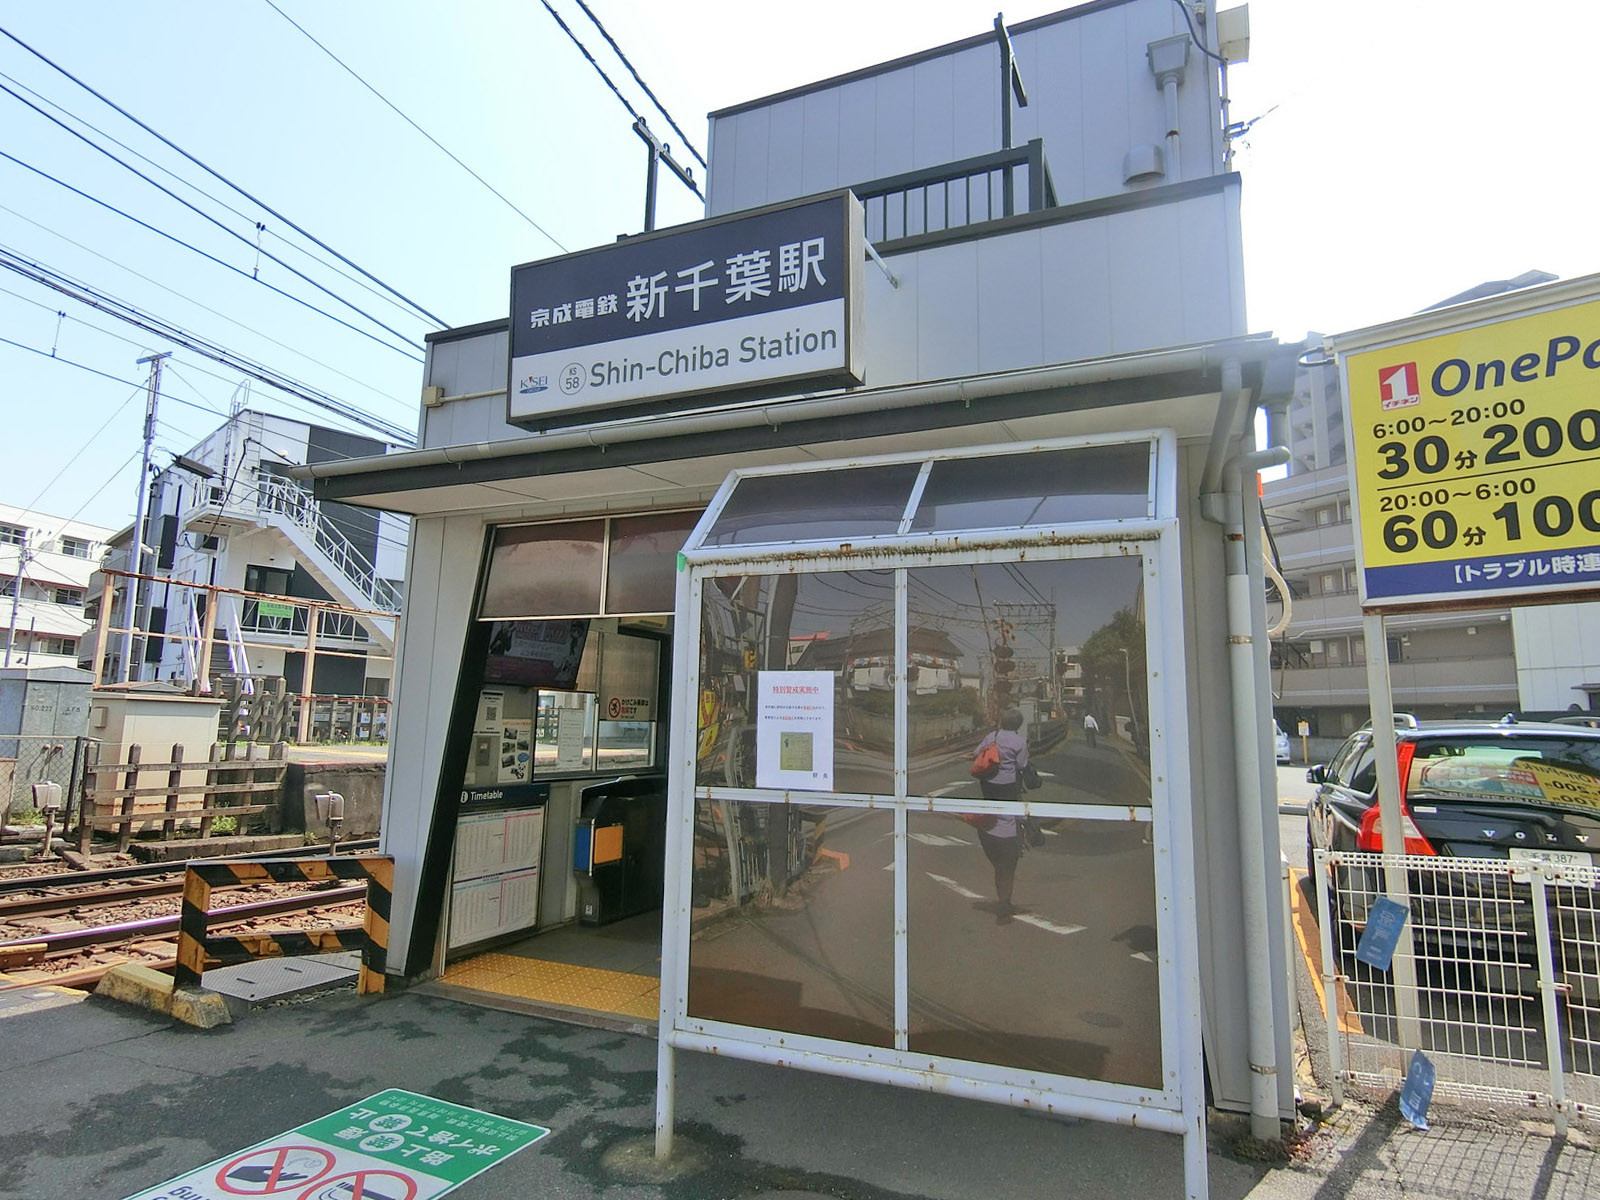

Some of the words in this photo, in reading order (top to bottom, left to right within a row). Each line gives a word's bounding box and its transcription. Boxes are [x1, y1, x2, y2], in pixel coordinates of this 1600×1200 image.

[530, 293, 619, 329] 京成電鉄
[625, 236, 827, 324] 新千葉駅
[590, 345, 729, 388] Shin-Chiba
[739, 328, 837, 364] Station
[565, 376, 580, 390] 58
[470, 789, 504, 801] Timetable
[332, 1124, 456, 1167] 路上禁煙
